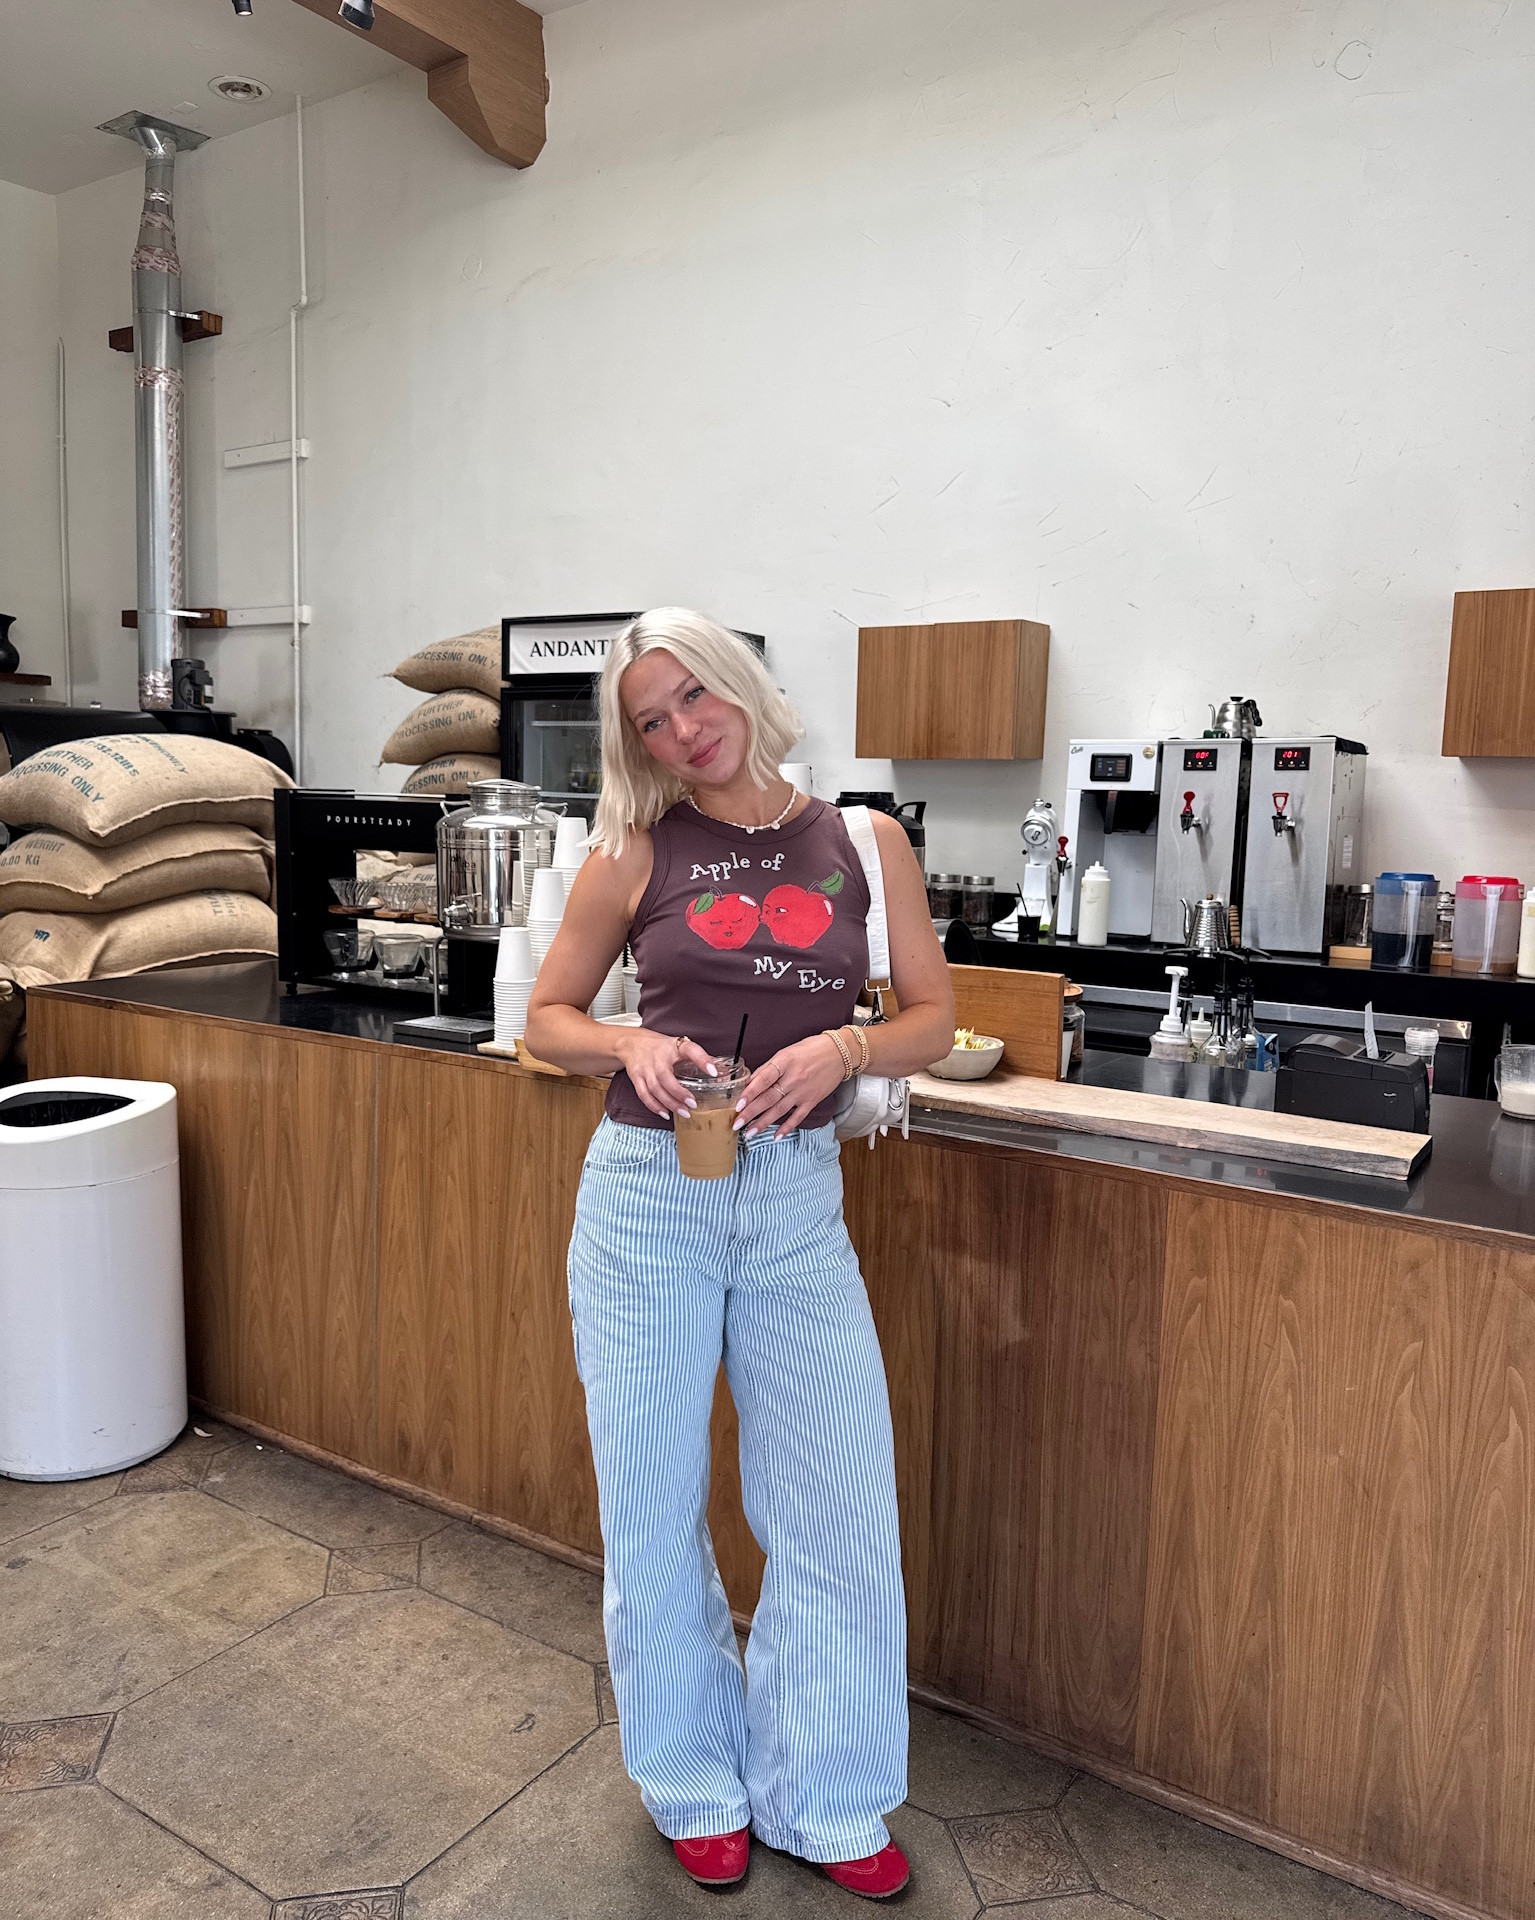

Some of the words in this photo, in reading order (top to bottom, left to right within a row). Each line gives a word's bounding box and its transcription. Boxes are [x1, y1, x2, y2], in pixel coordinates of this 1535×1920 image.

[530, 639, 609, 657] ANDANT
[468, 653, 498, 669] ONLY
[458, 708, 486, 722] ONLY
[41, 750, 94, 772] FURTHER
[451, 770, 480, 781] ONLY
[71, 775, 104, 804] ONLY
[326, 815, 412, 827] POURSTEADY
[25, 854, 40, 866] KG
[690, 852, 751, 882] Apple
[760, 853, 785, 871] of
[753, 956, 793, 980] My
[797, 969, 846, 993] Eye
